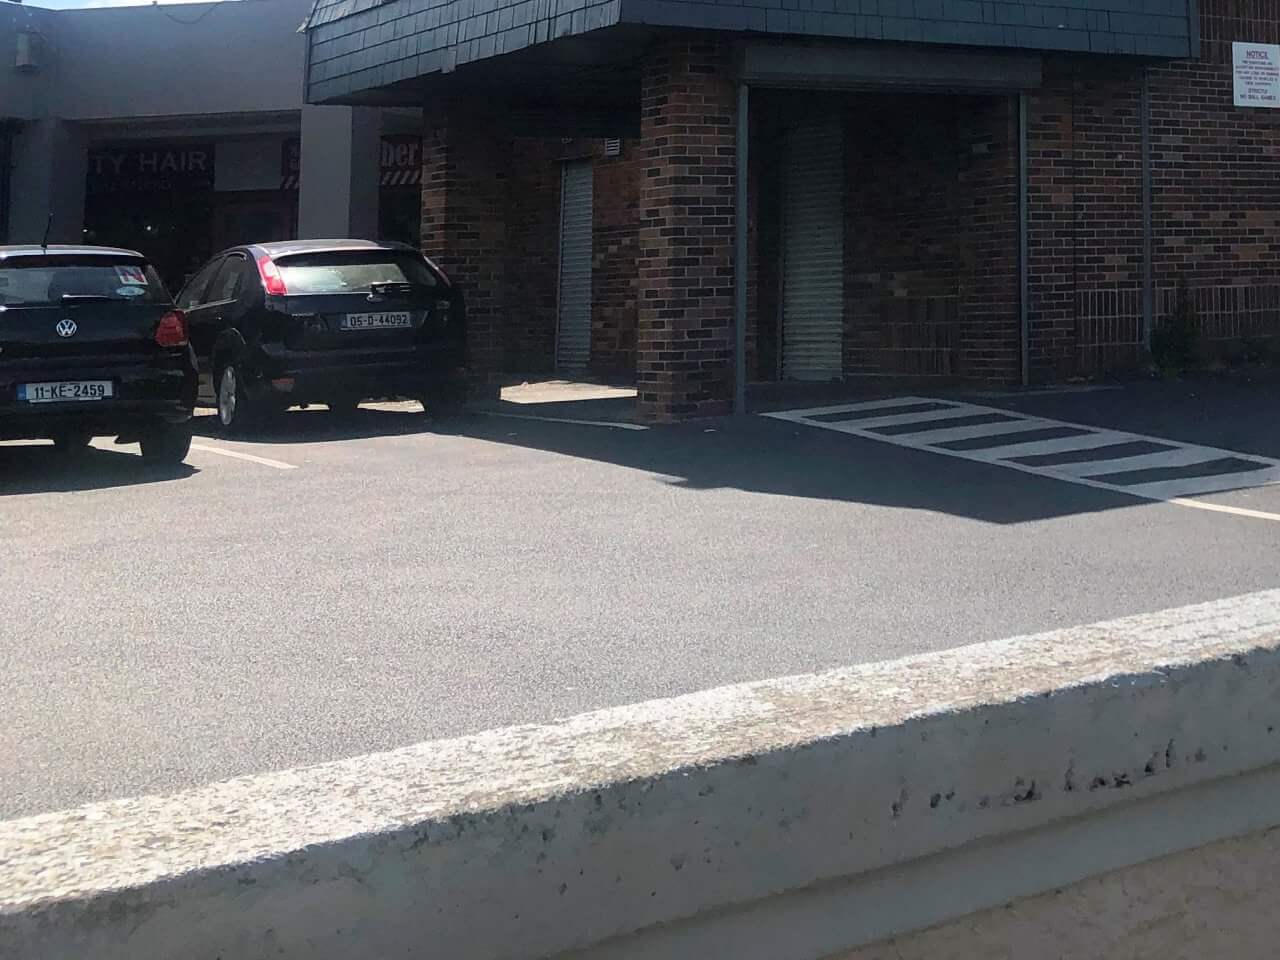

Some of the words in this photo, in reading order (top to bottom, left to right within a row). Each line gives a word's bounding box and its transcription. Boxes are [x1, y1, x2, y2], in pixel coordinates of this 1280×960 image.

[1246, 50, 1268, 58] NOTICE
[139, 151, 207, 172] HAIR
[34, 383, 105, 400] 11-KE-2459
